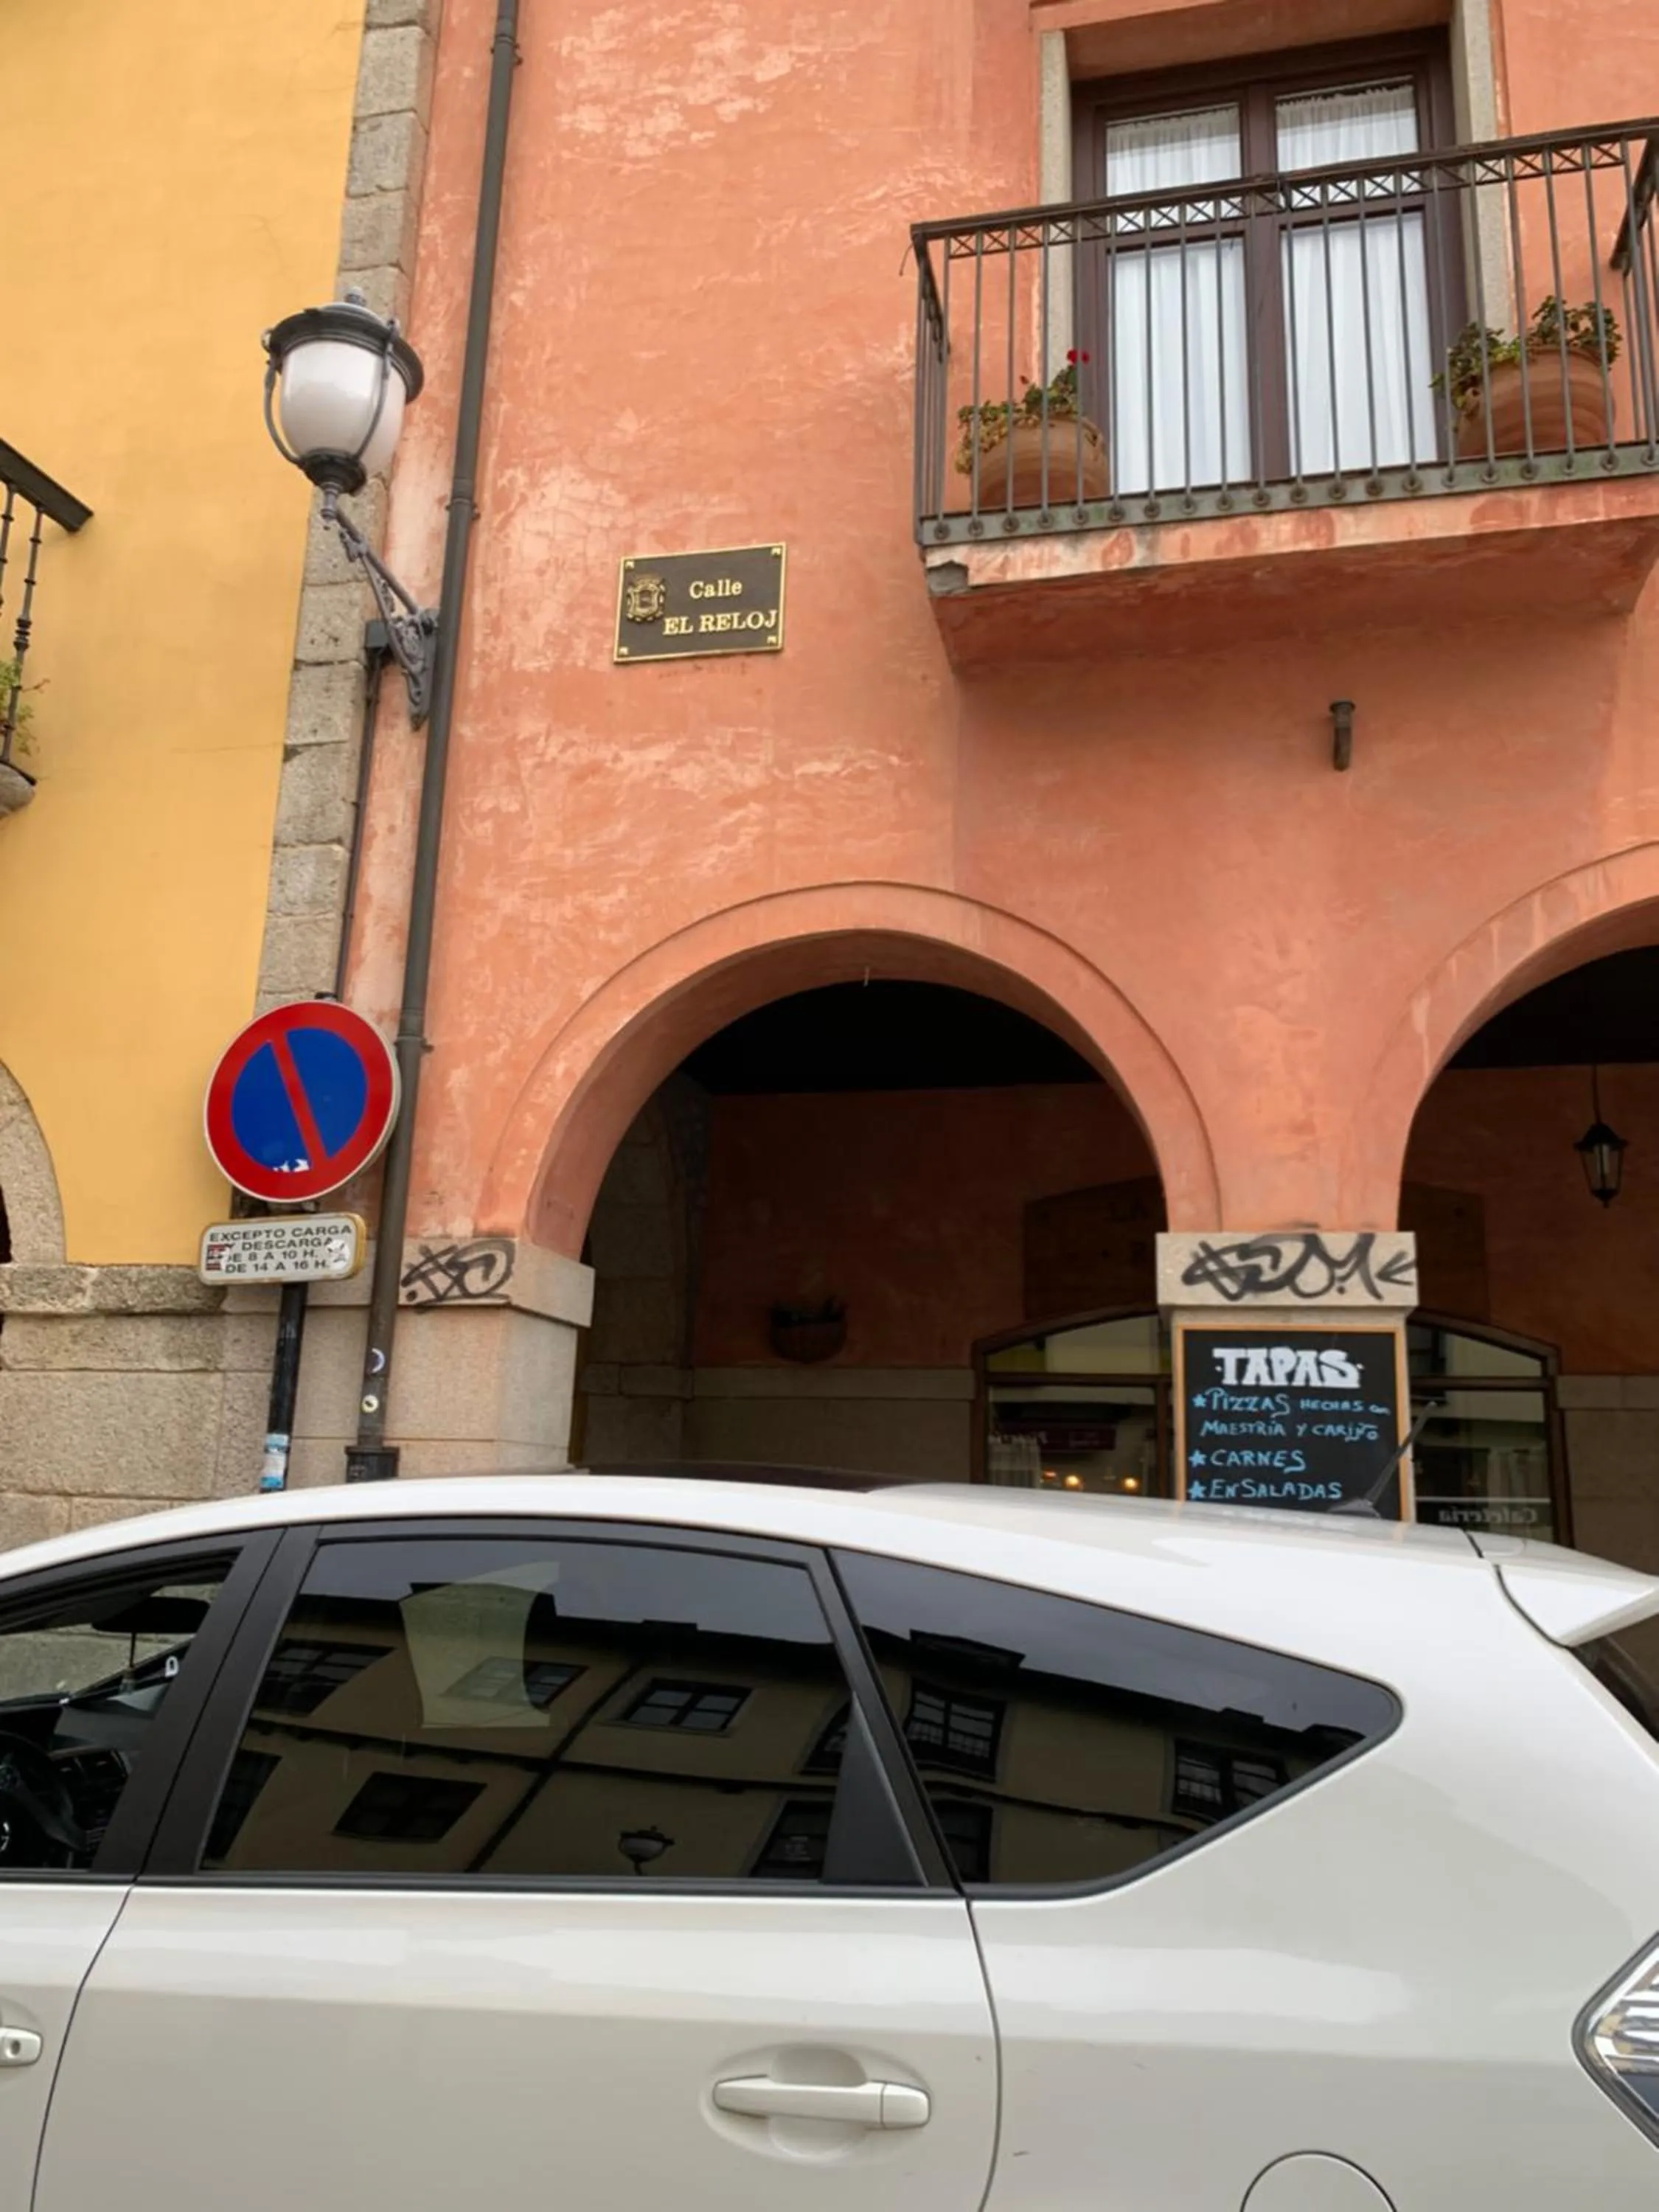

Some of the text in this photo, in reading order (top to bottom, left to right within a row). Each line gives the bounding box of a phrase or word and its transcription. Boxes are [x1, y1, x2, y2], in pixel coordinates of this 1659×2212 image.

[689, 579, 743, 599] Calle
[662, 609, 778, 636] EL RELOJ
[209, 1225, 352, 1242] EXCEPTO CARGA
[227, 1253, 242, 1263] E
[248, 1252, 257, 1262] 8
[263, 1251, 274, 1261] A
[282, 1250, 296, 1259] 10
[225, 1264, 248, 1273] DE
[254, 1263, 268, 1272] 14
[275, 1262, 286, 1271] A
[293, 1260, 308, 1270] 16
[1209, 1450, 1307, 1474] CARNES
